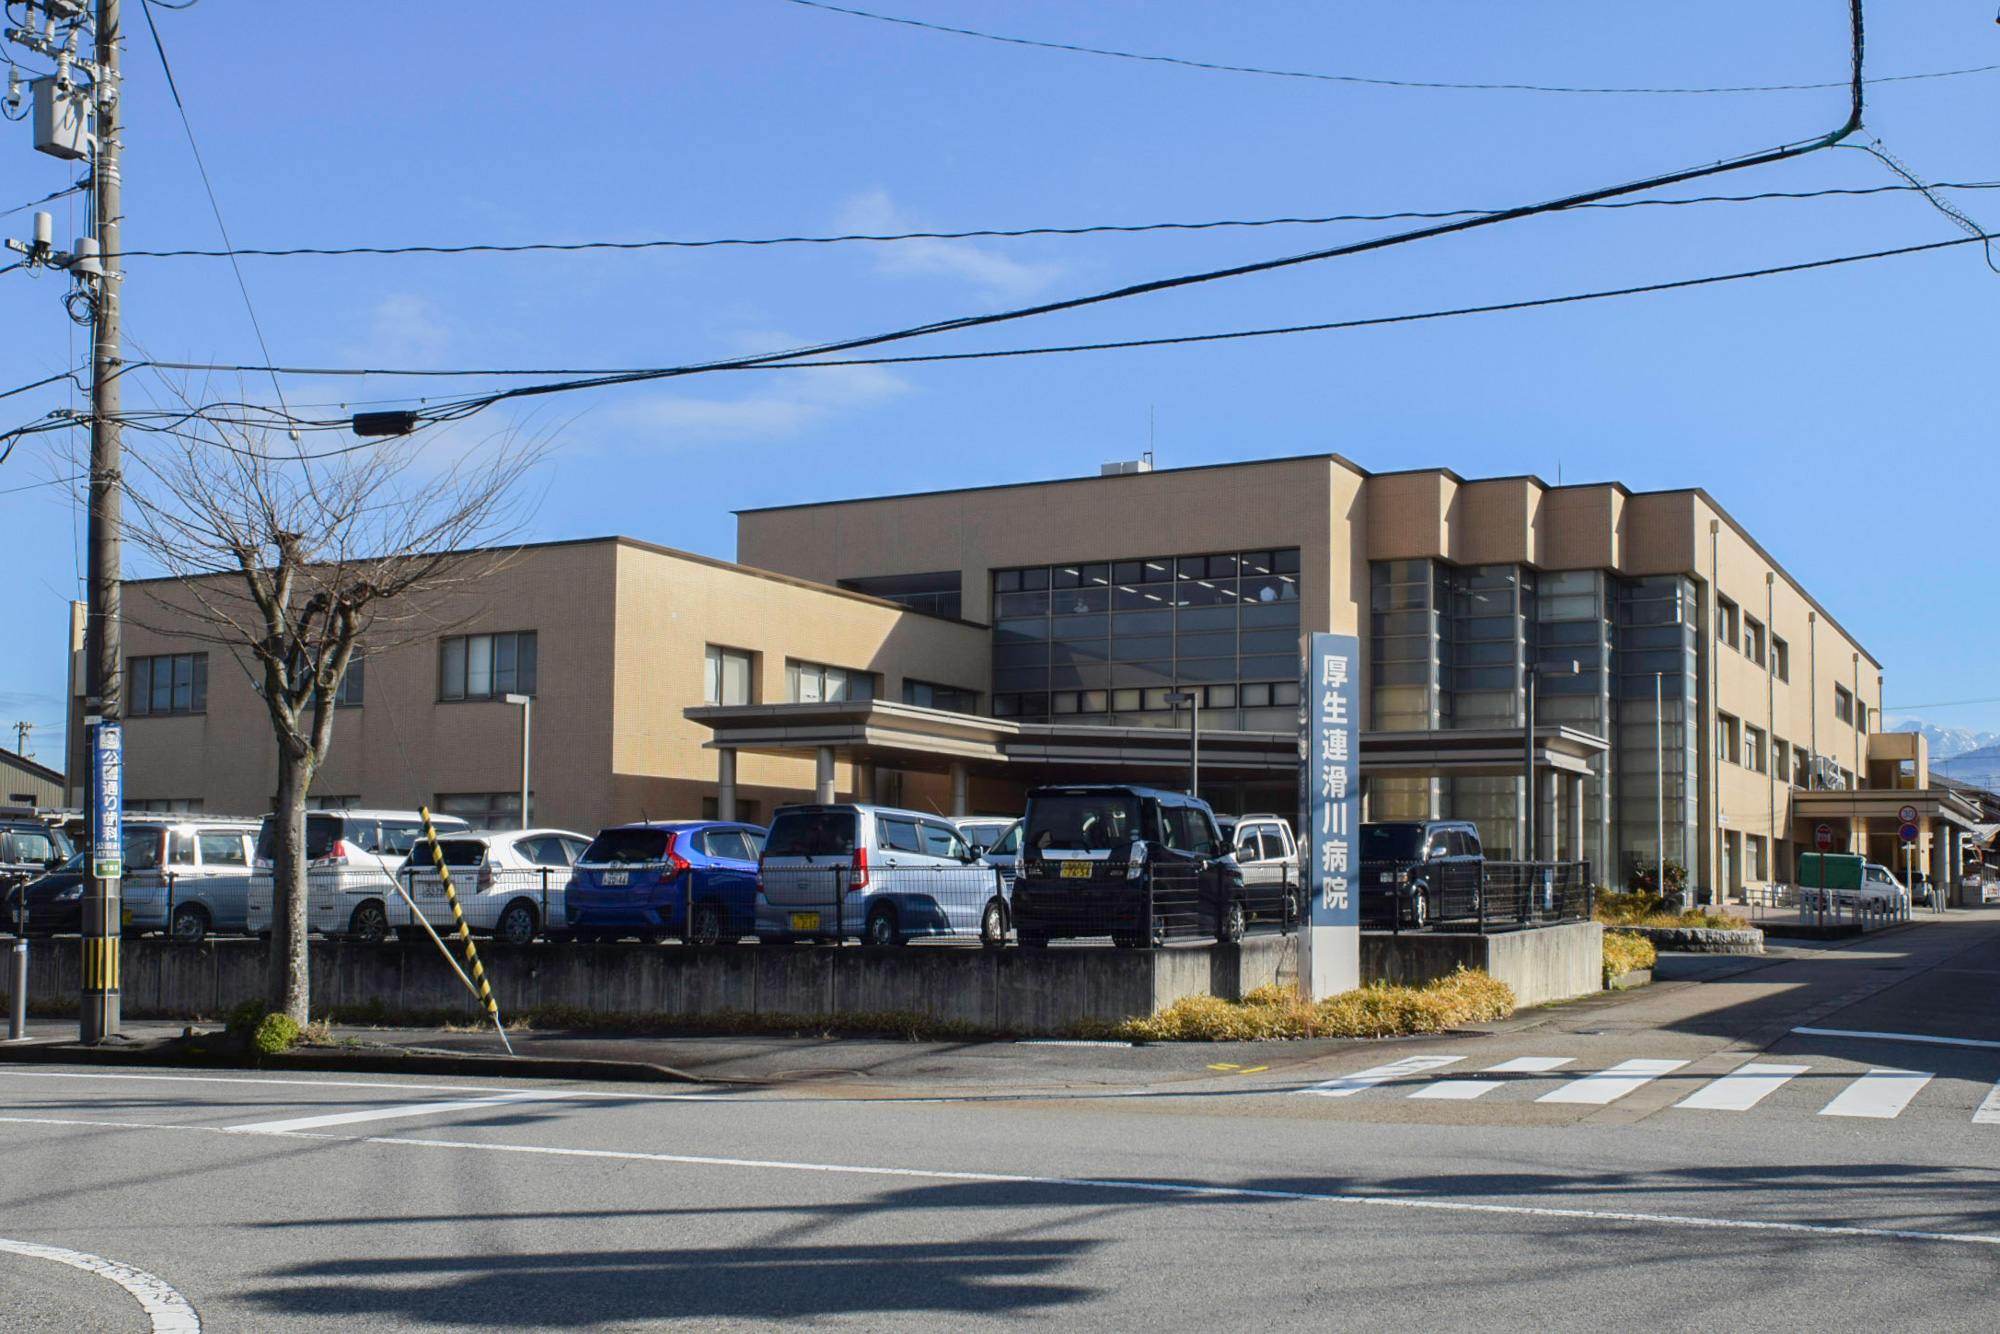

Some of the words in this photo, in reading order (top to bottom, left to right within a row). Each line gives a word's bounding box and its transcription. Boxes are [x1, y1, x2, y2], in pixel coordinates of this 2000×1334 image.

[102, 750, 118, 841] 公園通り歯科
[1322, 654, 1348, 910] 厚生連滑川病院
[1903, 809, 1914, 818] 30
